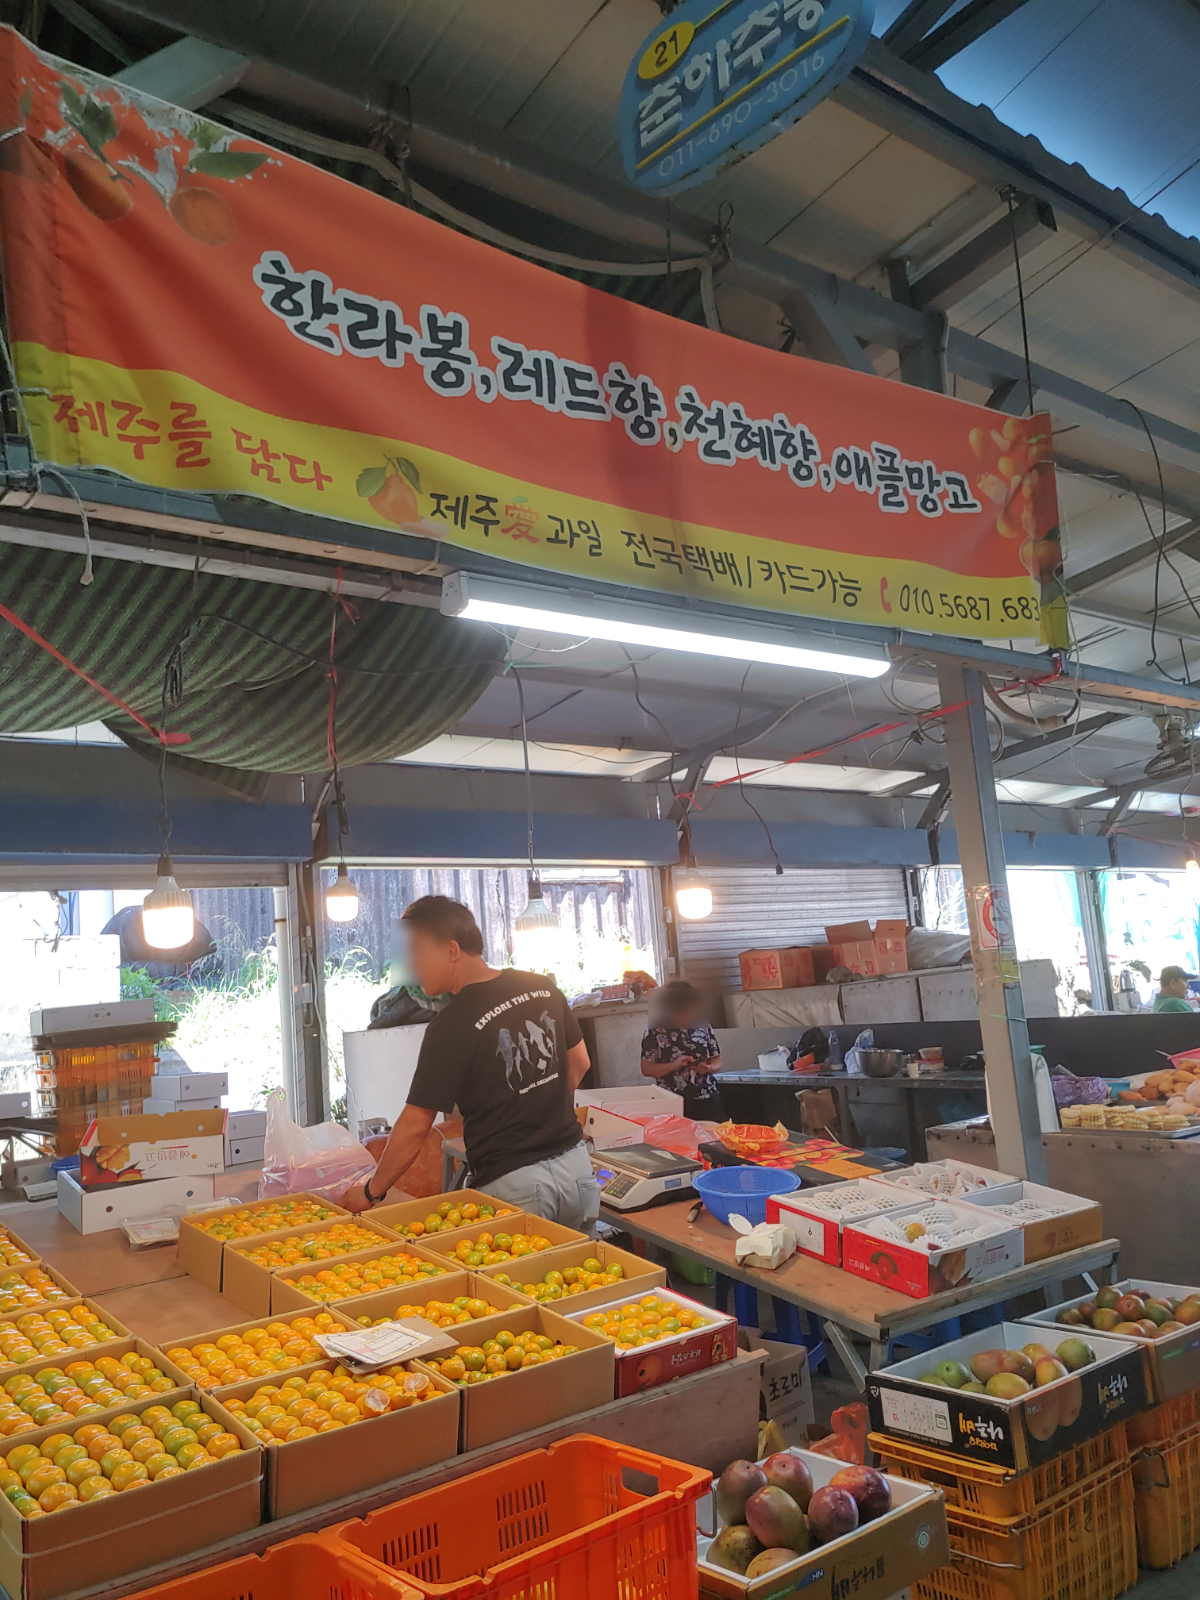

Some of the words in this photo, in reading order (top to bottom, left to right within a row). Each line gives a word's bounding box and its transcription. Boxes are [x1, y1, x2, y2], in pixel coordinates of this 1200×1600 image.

[654, 30, 678, 69] 21
[658, 52, 826, 177] 011-690-3016
[50, 394, 212, 469] 제주를
[231, 426, 334, 491] 담다
[620, 529, 863, 609] 전국택배/카드가능
[475, 1001, 513, 1031] EXPLORE
[511, 993, 531, 1006] THE
[530, 989, 551, 998] WILD
[145, 1149, 190, 1162] 애플망고
[958, 1412, 1004, 1441] 나주배
